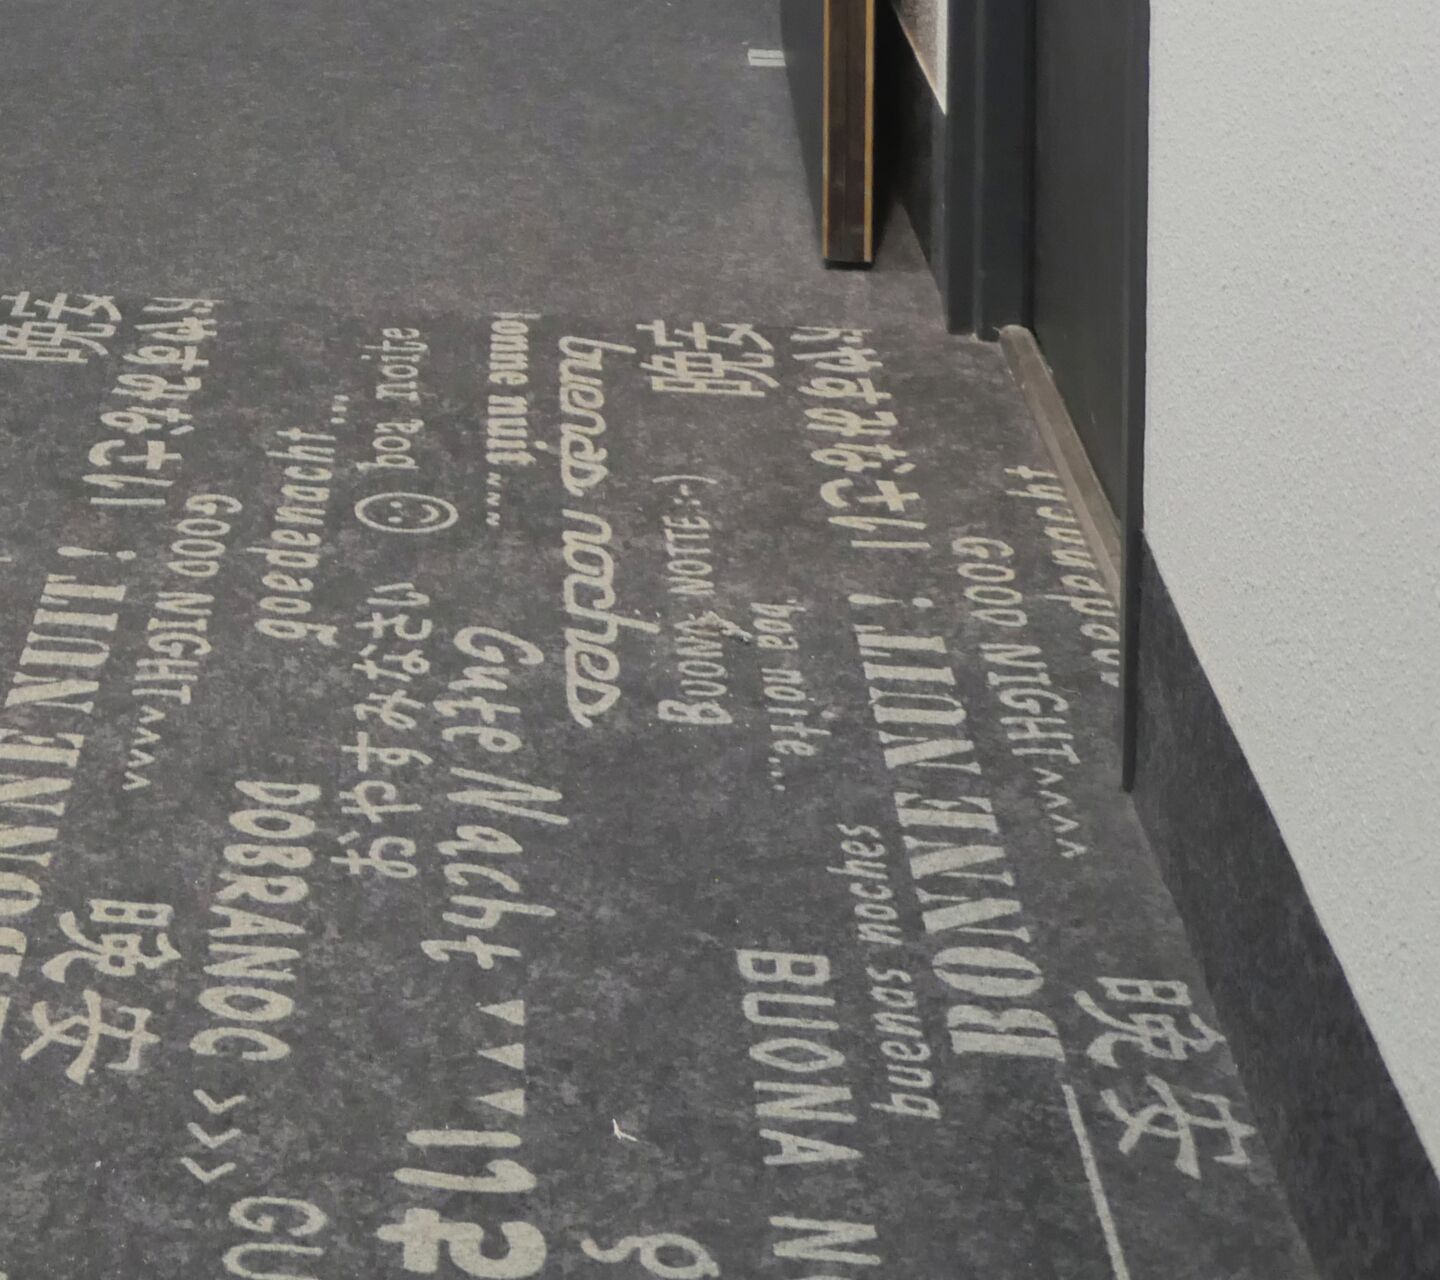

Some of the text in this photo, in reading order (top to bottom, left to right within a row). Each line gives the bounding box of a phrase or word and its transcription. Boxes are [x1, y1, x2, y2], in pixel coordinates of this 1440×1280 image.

[354, 327, 428, 471] boa noite
[484, 394, 549, 465] nuit
[131, 493, 242, 704] GOOD NIGHT
[558, 335, 674, 728] buenas noches
[662, 515, 715, 596] NOTTE
[750, 599, 807, 649] boa
[4, 573, 126, 713] NUIT
[853, 624, 981, 773] NUIT
[950, 536, 1081, 763] GOOD NIGHT
[419, 624, 570, 968] Gute Nacht
[188, 779, 321, 1061] DOBRANOC
[826, 823, 941, 1119] buenas noches
[893, 791, 1065, 1062] BONNE
[735, 948, 862, 1165] BUONA
